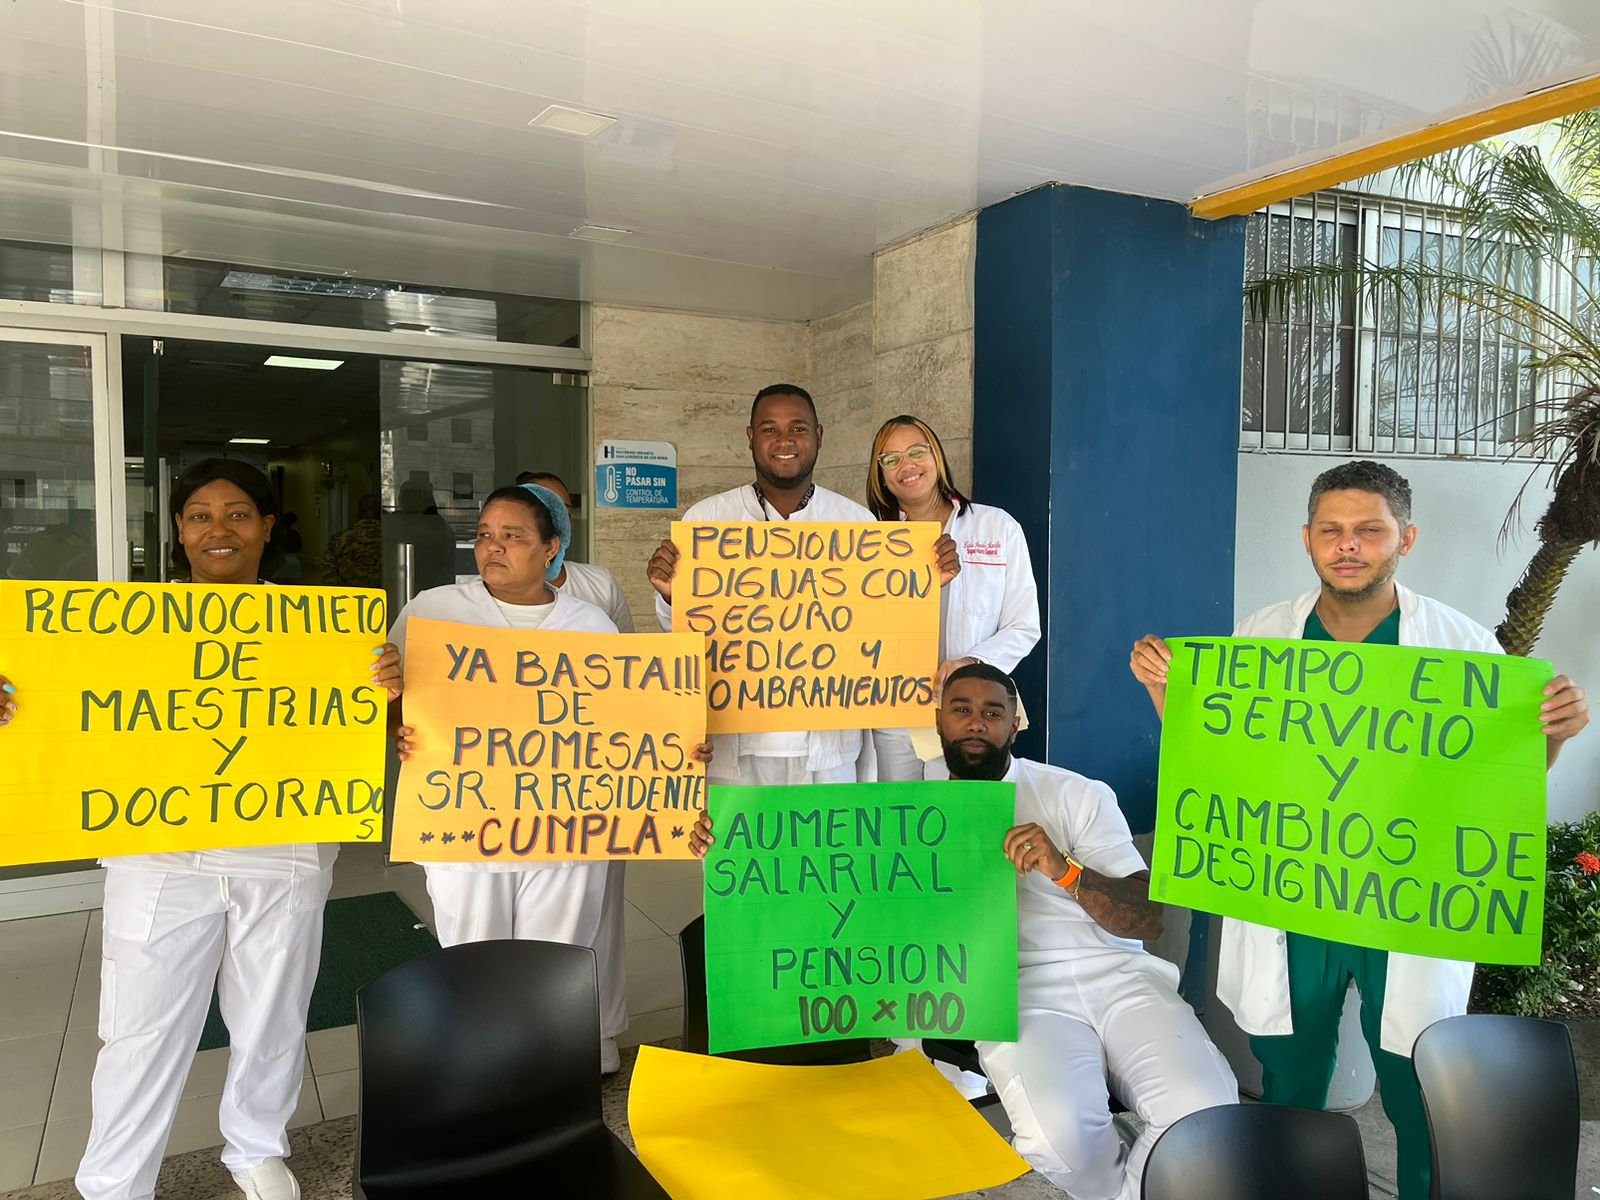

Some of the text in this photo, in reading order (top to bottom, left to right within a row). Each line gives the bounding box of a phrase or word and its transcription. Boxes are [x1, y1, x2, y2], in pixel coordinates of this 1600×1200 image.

[625, 467, 637, 476] NO
[625, 477, 666, 487] PASAR SIN
[625, 489, 653, 497] CONTROL
[626, 496, 669, 504] TEMPERATURA
[692, 526, 914, 562] PENSIONES
[692, 565, 932, 600] DIGNAS CON
[25, 588, 385, 635] RECONOCIMIETO
[686, 601, 852, 636] SEGURO
[193, 640, 263, 682] DE
[446, 644, 701, 696] YA BASTA!!!
[1184, 641, 1500, 709] TIEMPO EN
[81, 686, 378, 732] MAESTRIAS
[537, 690, 594, 725] DE
[706, 673, 934, 711] OMBRAMIENTOS
[1203, 692, 1475, 760] SERVICIO
[211, 736, 248, 776] Y
[453, 727, 694, 771] PROMESAS.
[418, 770, 496, 811] SR.
[1316, 754, 1359, 802] Y
[723, 804, 947, 850] AUMENTO
[1174, 788, 1536, 882] CAMBIOS DE
[707, 851, 953, 896] SALARIAL
[1172, 836, 1529, 935] DESIGNACIÓN
[828, 899, 856, 940] Y
[772, 943, 967, 990] PENSION
[799, 994, 858, 1036] 100
[906, 990, 965, 1034] 100
